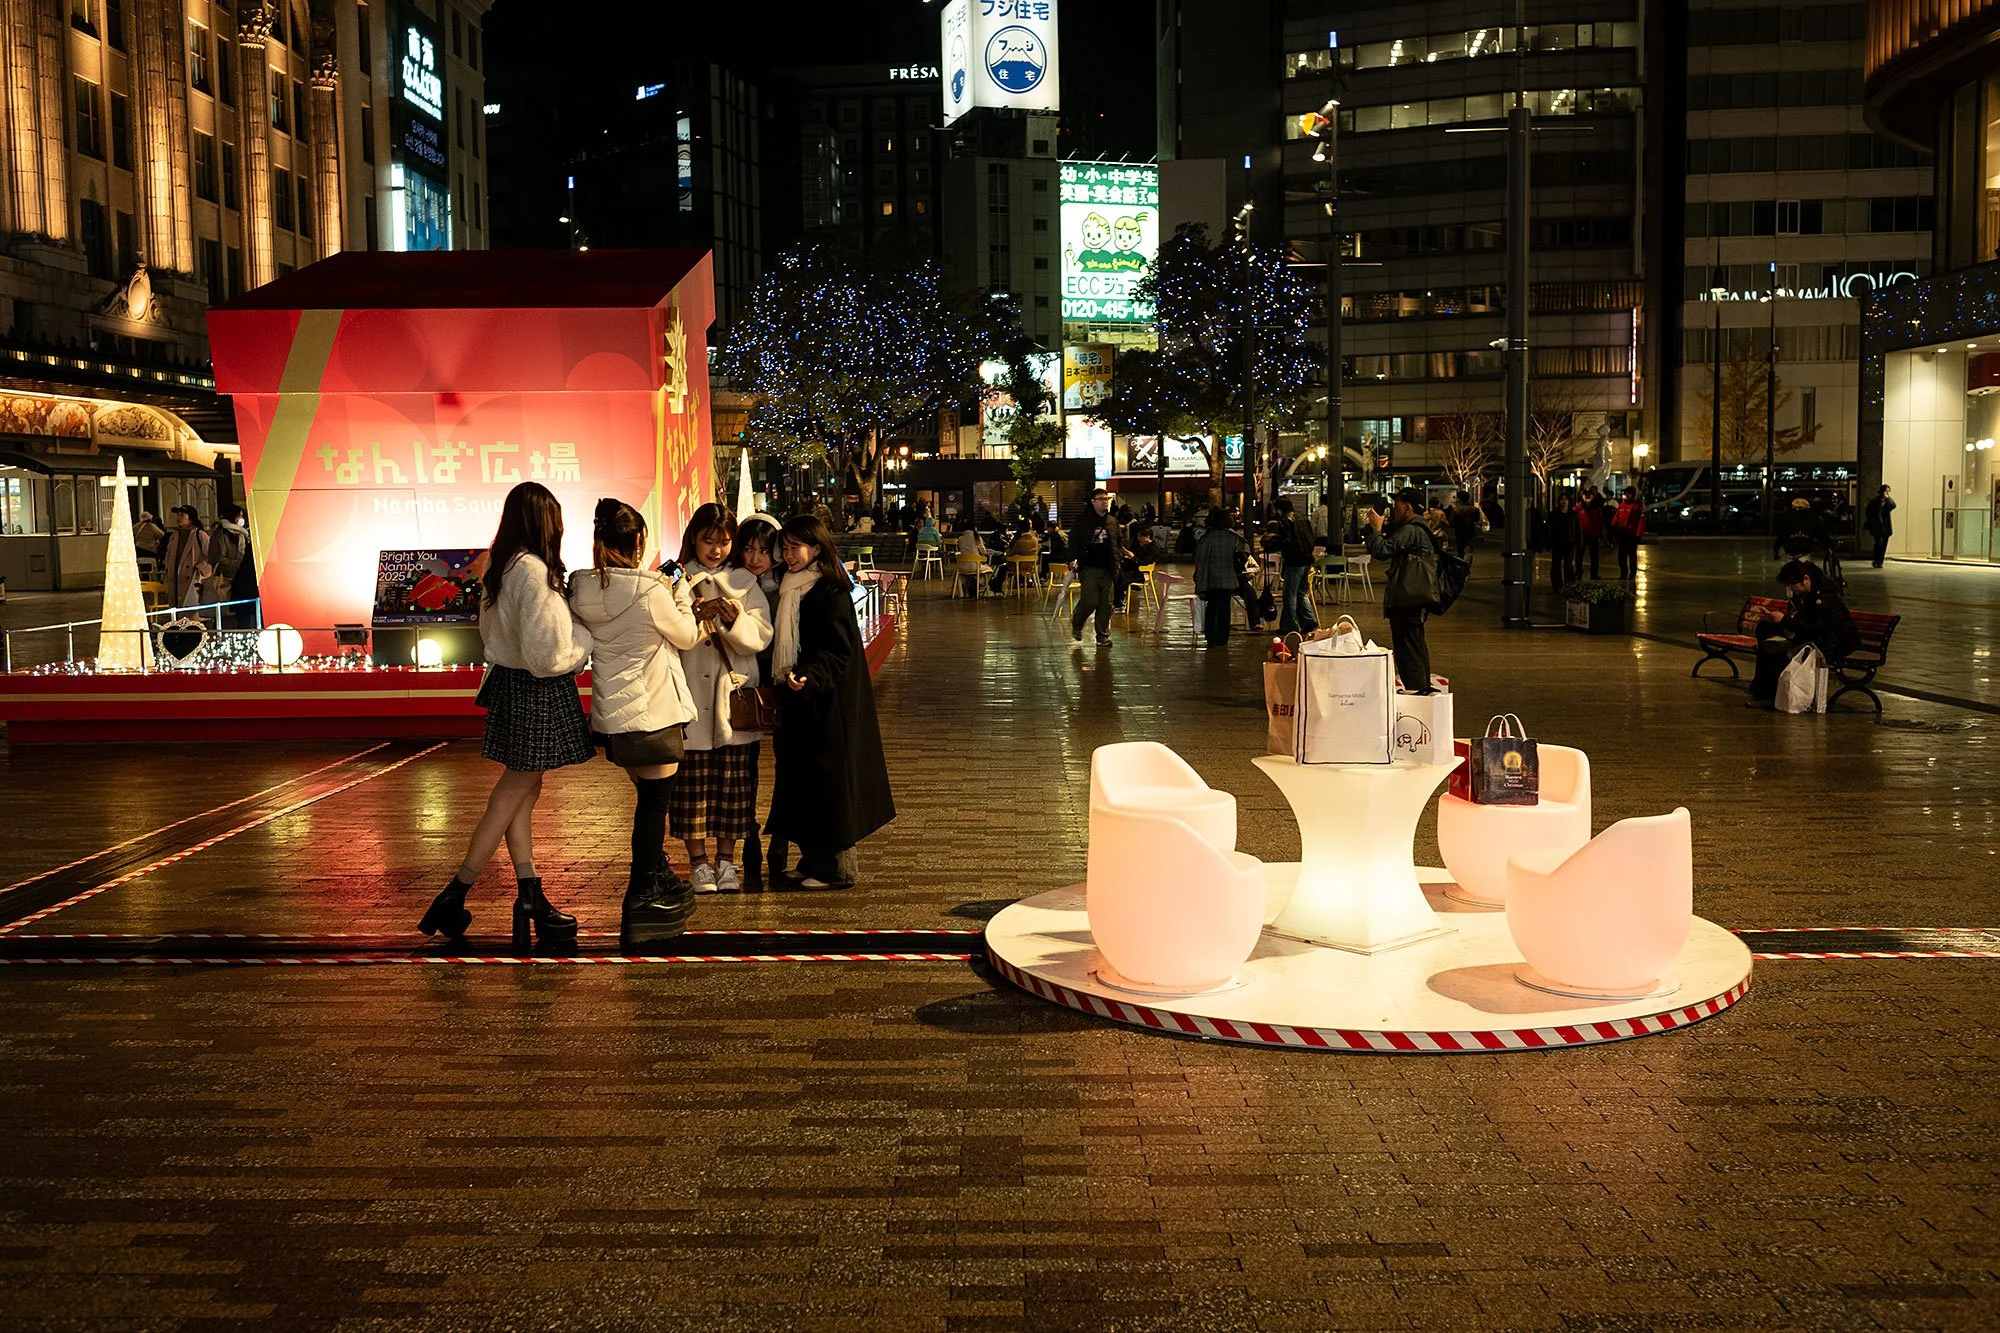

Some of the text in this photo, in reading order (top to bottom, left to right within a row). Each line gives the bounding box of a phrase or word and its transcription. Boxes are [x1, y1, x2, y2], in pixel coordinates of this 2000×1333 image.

[980, 0, 1050, 21] フジ住宅
[889, 64, 939, 79] FRÉSA
[1067, 276, 1100, 295] ECC
[1066, 364, 1111, 377] 日本一の民泊
[316, 441, 581, 484] なんば広場
[374, 496, 449, 515] Namba
[380, 551, 437, 563] Bright You
[379, 562, 424, 571] Namba
[378, 571, 406, 581] 2025
